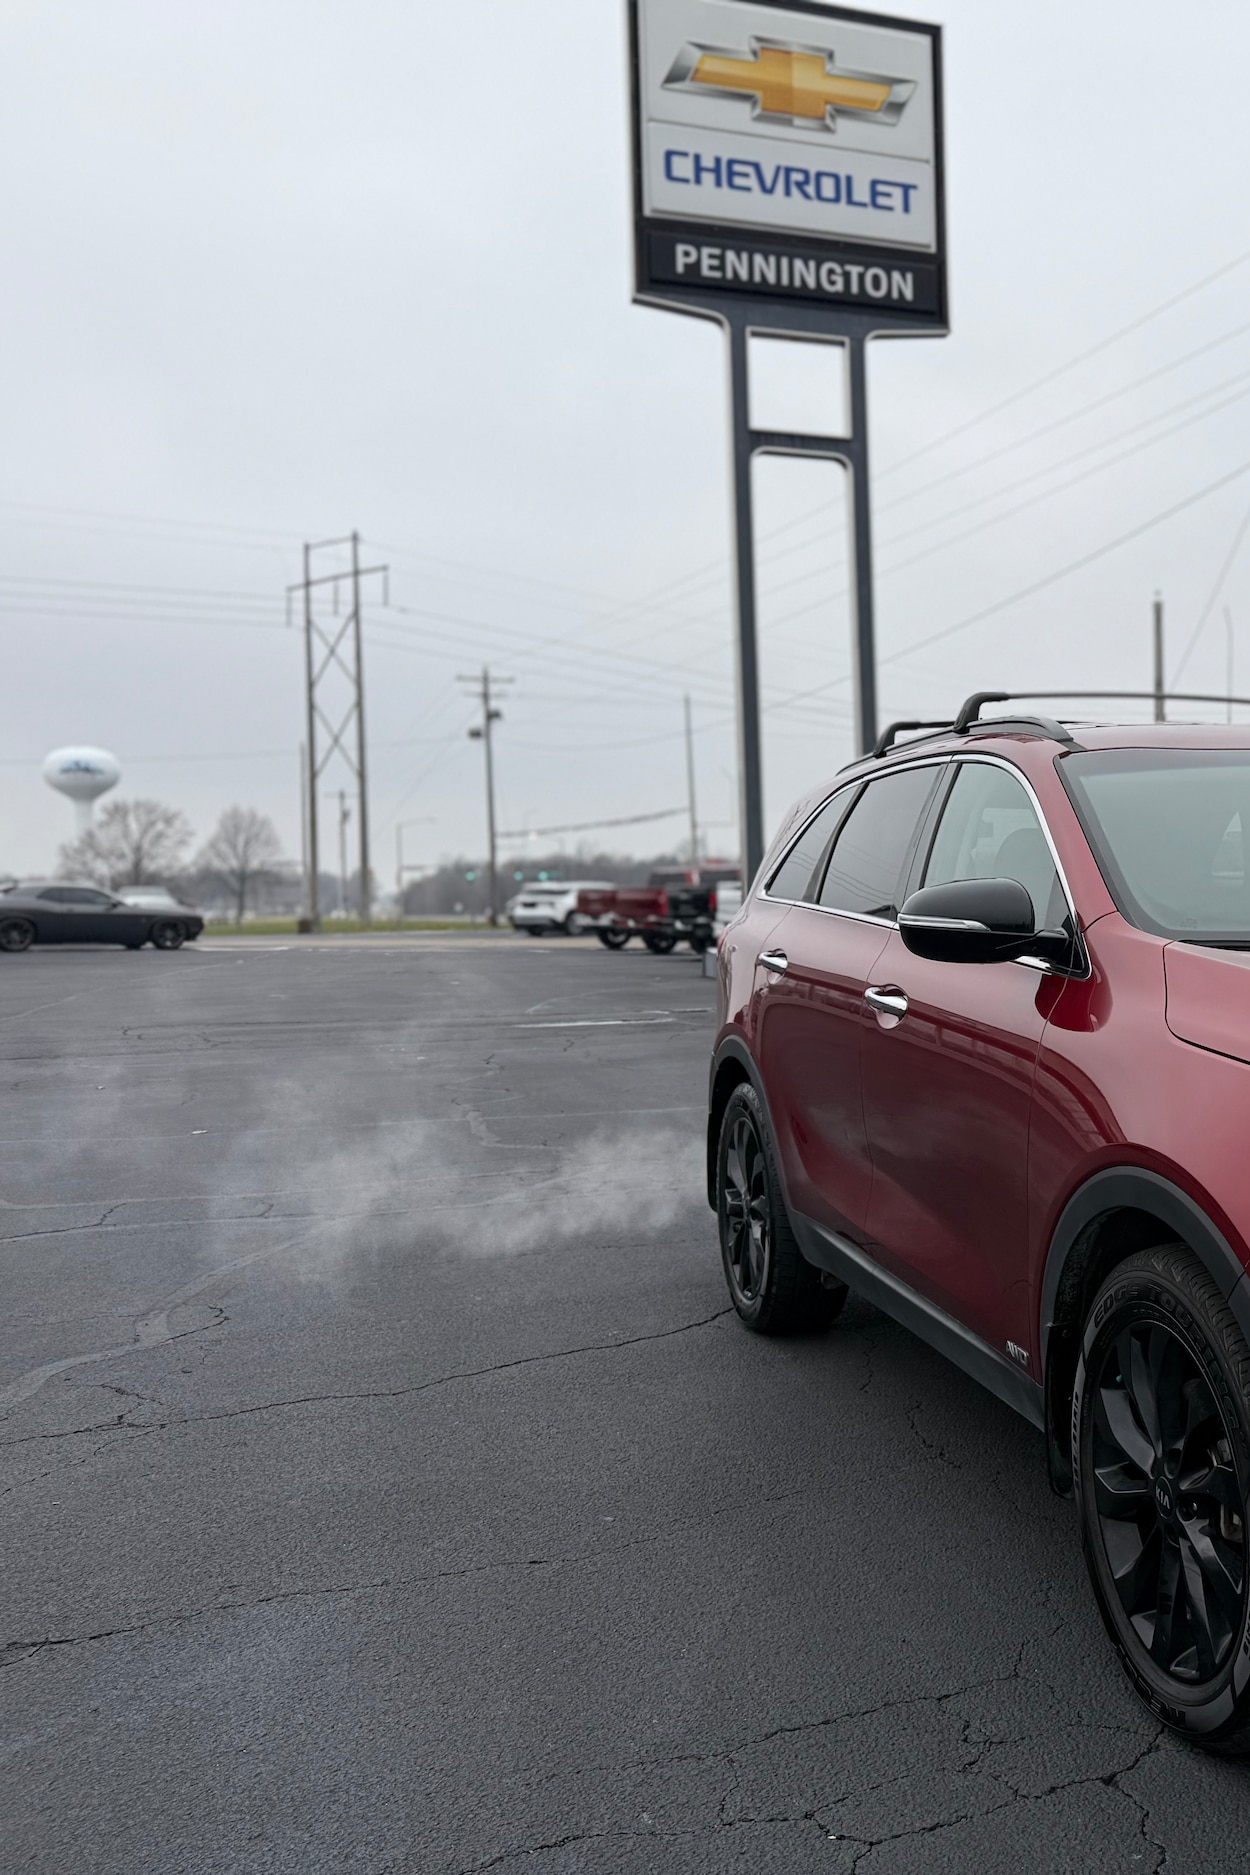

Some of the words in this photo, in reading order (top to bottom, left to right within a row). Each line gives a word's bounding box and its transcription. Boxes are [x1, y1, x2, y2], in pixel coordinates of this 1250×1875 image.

[664, 150, 918, 214] CHEVROLET
[675, 243, 914, 302] PENNINGTON
[1095, 1284, 1140, 1328] EDGE
[1147, 1283, 1240, 1429] TOURING
[1156, 1485, 1171, 1510] KIA
